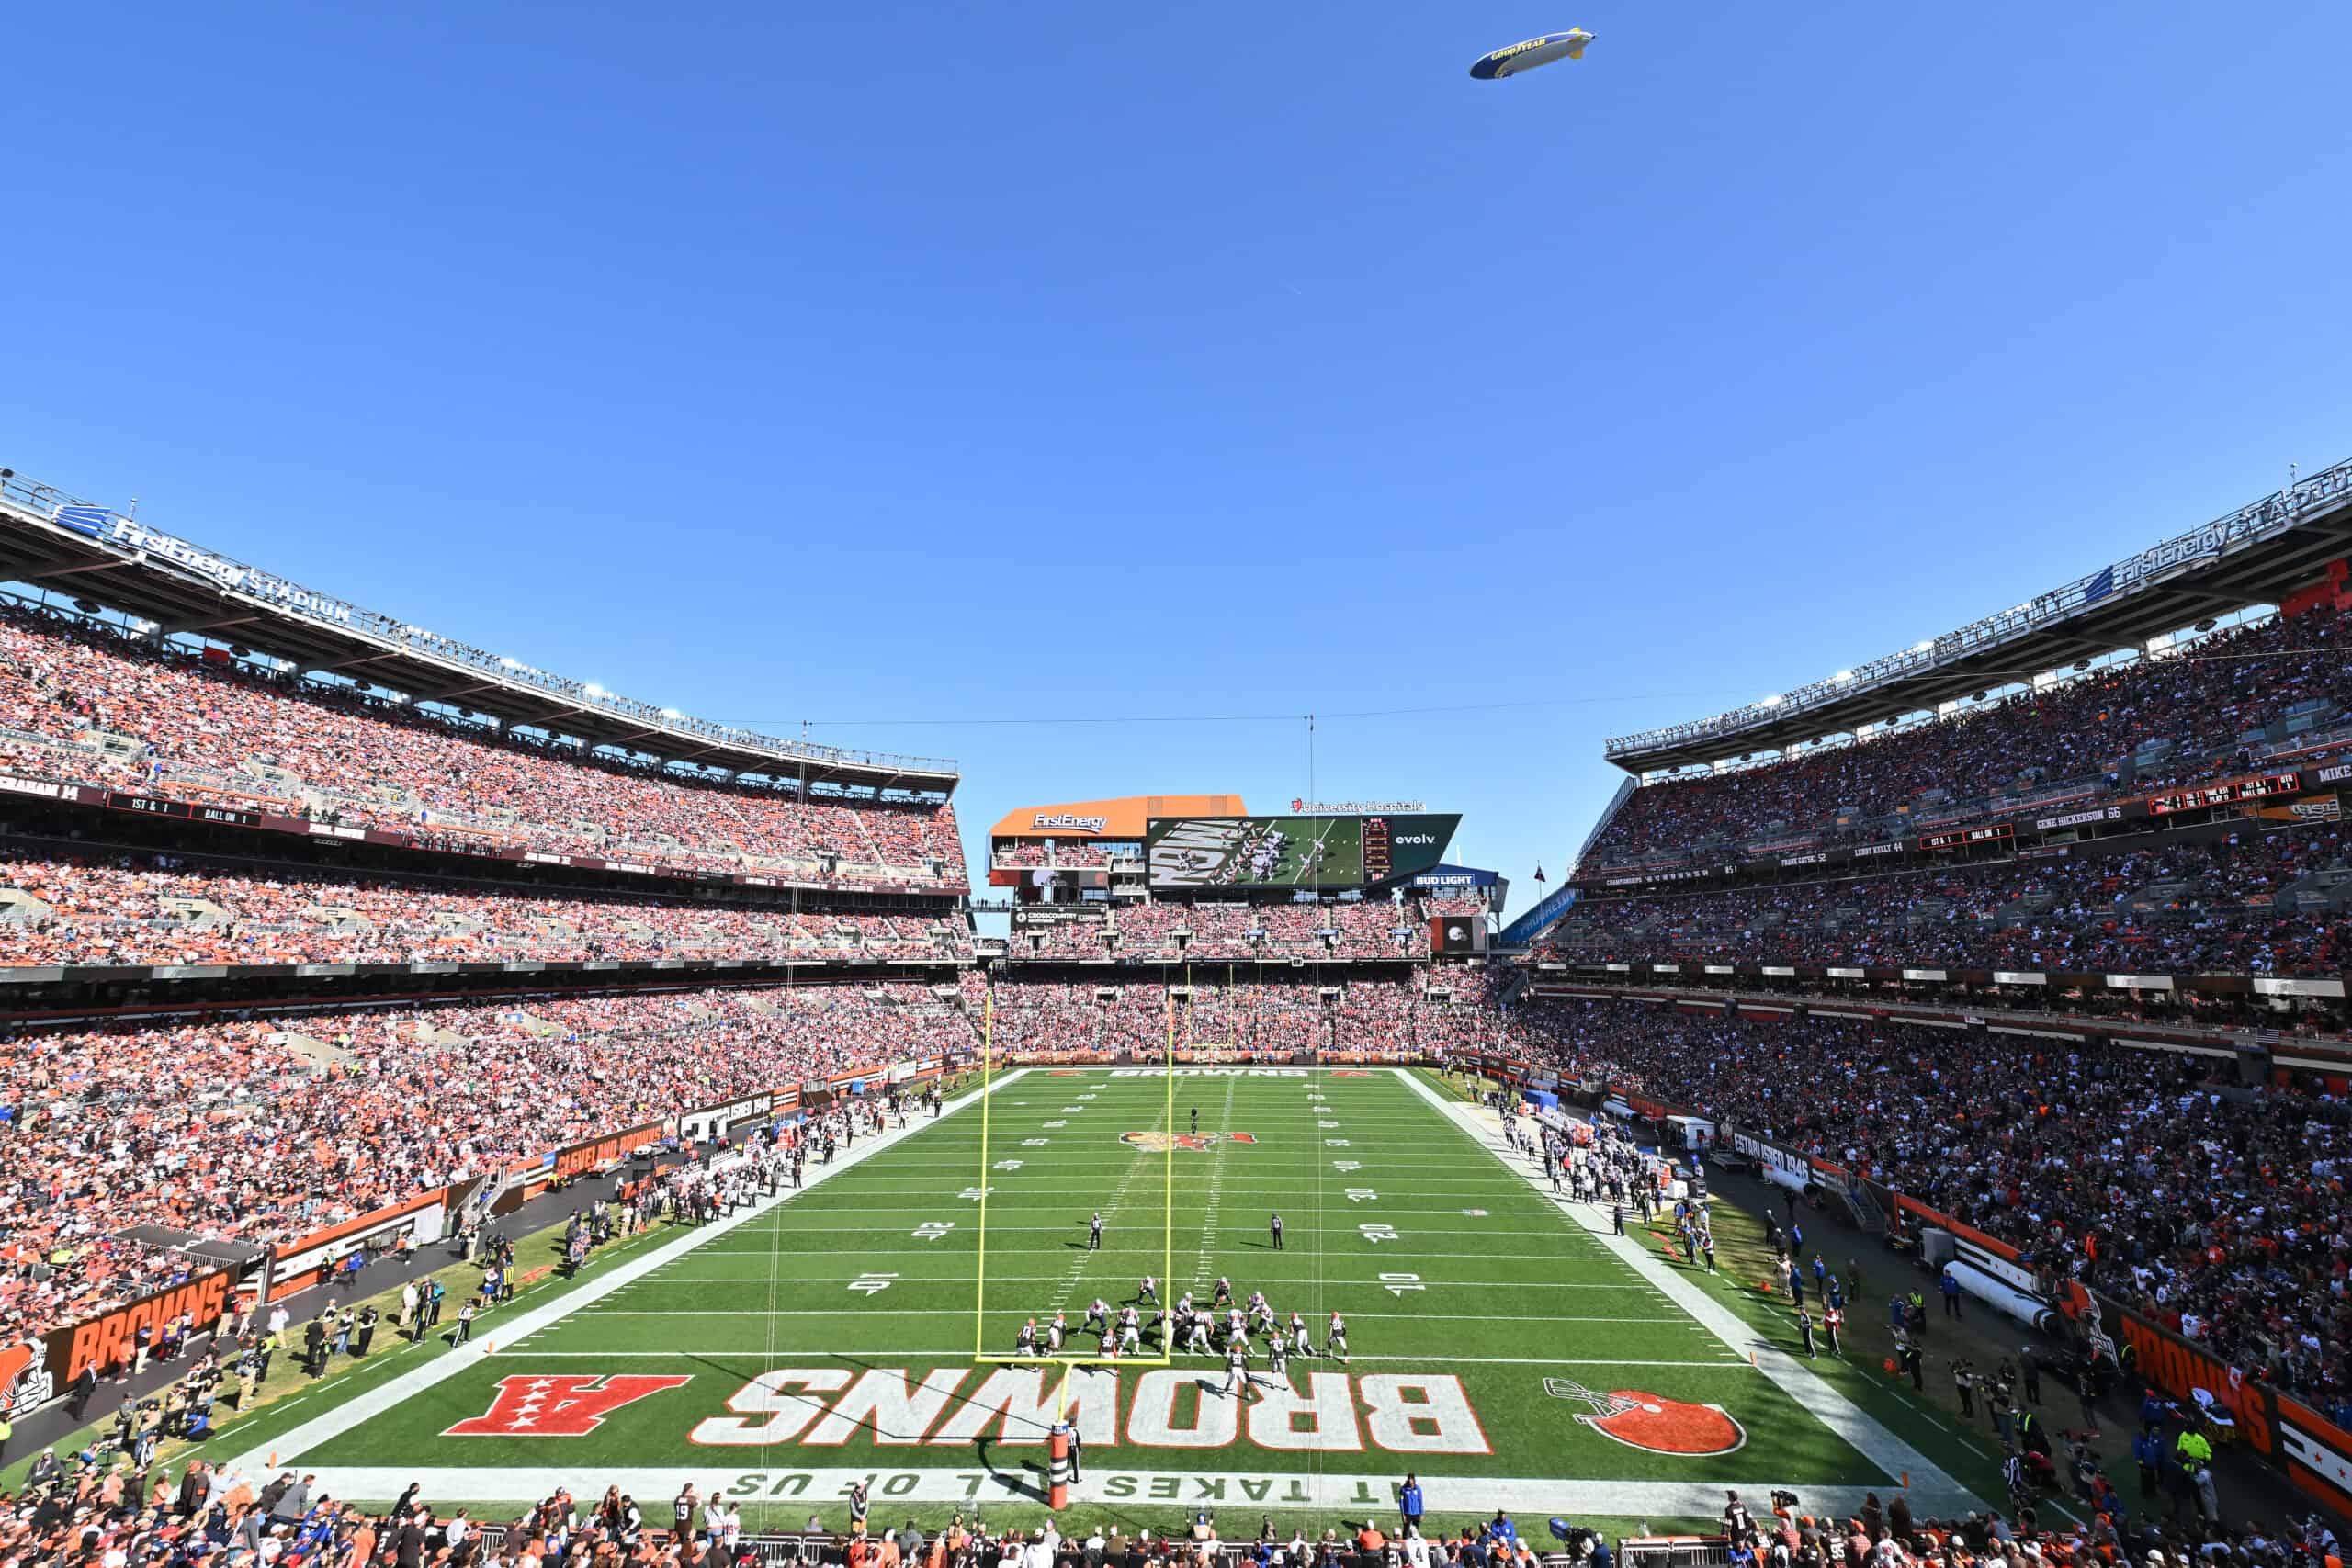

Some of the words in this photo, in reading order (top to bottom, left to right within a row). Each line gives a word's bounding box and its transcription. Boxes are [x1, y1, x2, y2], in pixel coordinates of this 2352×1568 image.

[1491, 39, 1545, 60] GOODYEAR
[112, 519, 246, 586] FirstEnergy
[2120, 521, 2231, 582] FirstEnergy
[2318, 764, 2352, 783] MIKE
[132, 798, 145, 809] 1ST
[1303, 802, 1363, 814] University
[1367, 800, 1427, 812] Hospitals
[205, 809, 223, 821] BALL
[225, 811, 235, 822] ON
[1035, 814, 1107, 829] FirstEnergy
[2037, 818, 2057, 829] GENE
[2058, 810, 2104, 827] HICKERSON
[2108, 807, 2121, 819] 66
[1396, 834, 1435, 844] evolv
[1894, 841, 1903, 852] 44
[1416, 875, 1439, 885] BUD
[1441, 875, 1472, 885] LIGHT
[558, 1138, 619, 1177] CLEVELAND
[619, 1125, 662, 1153] BROWNS
[1734, 1133, 1784, 1169] ESTABLISHED
[1785, 1153, 1809, 1182] 1946
[67, 1272, 228, 1382] BROWNS
[2121, 1314, 2272, 1455] BROWNS
[687, 1367, 1495, 1456] BROWNS
[726, 1473, 813, 1495] US
[1103, 1475, 1311, 1503] TAKES
[675, 1505, 689, 1520] 19
[1416, 1547, 1423, 1562] 4
[1830, 1543, 1846, 1559] 95
